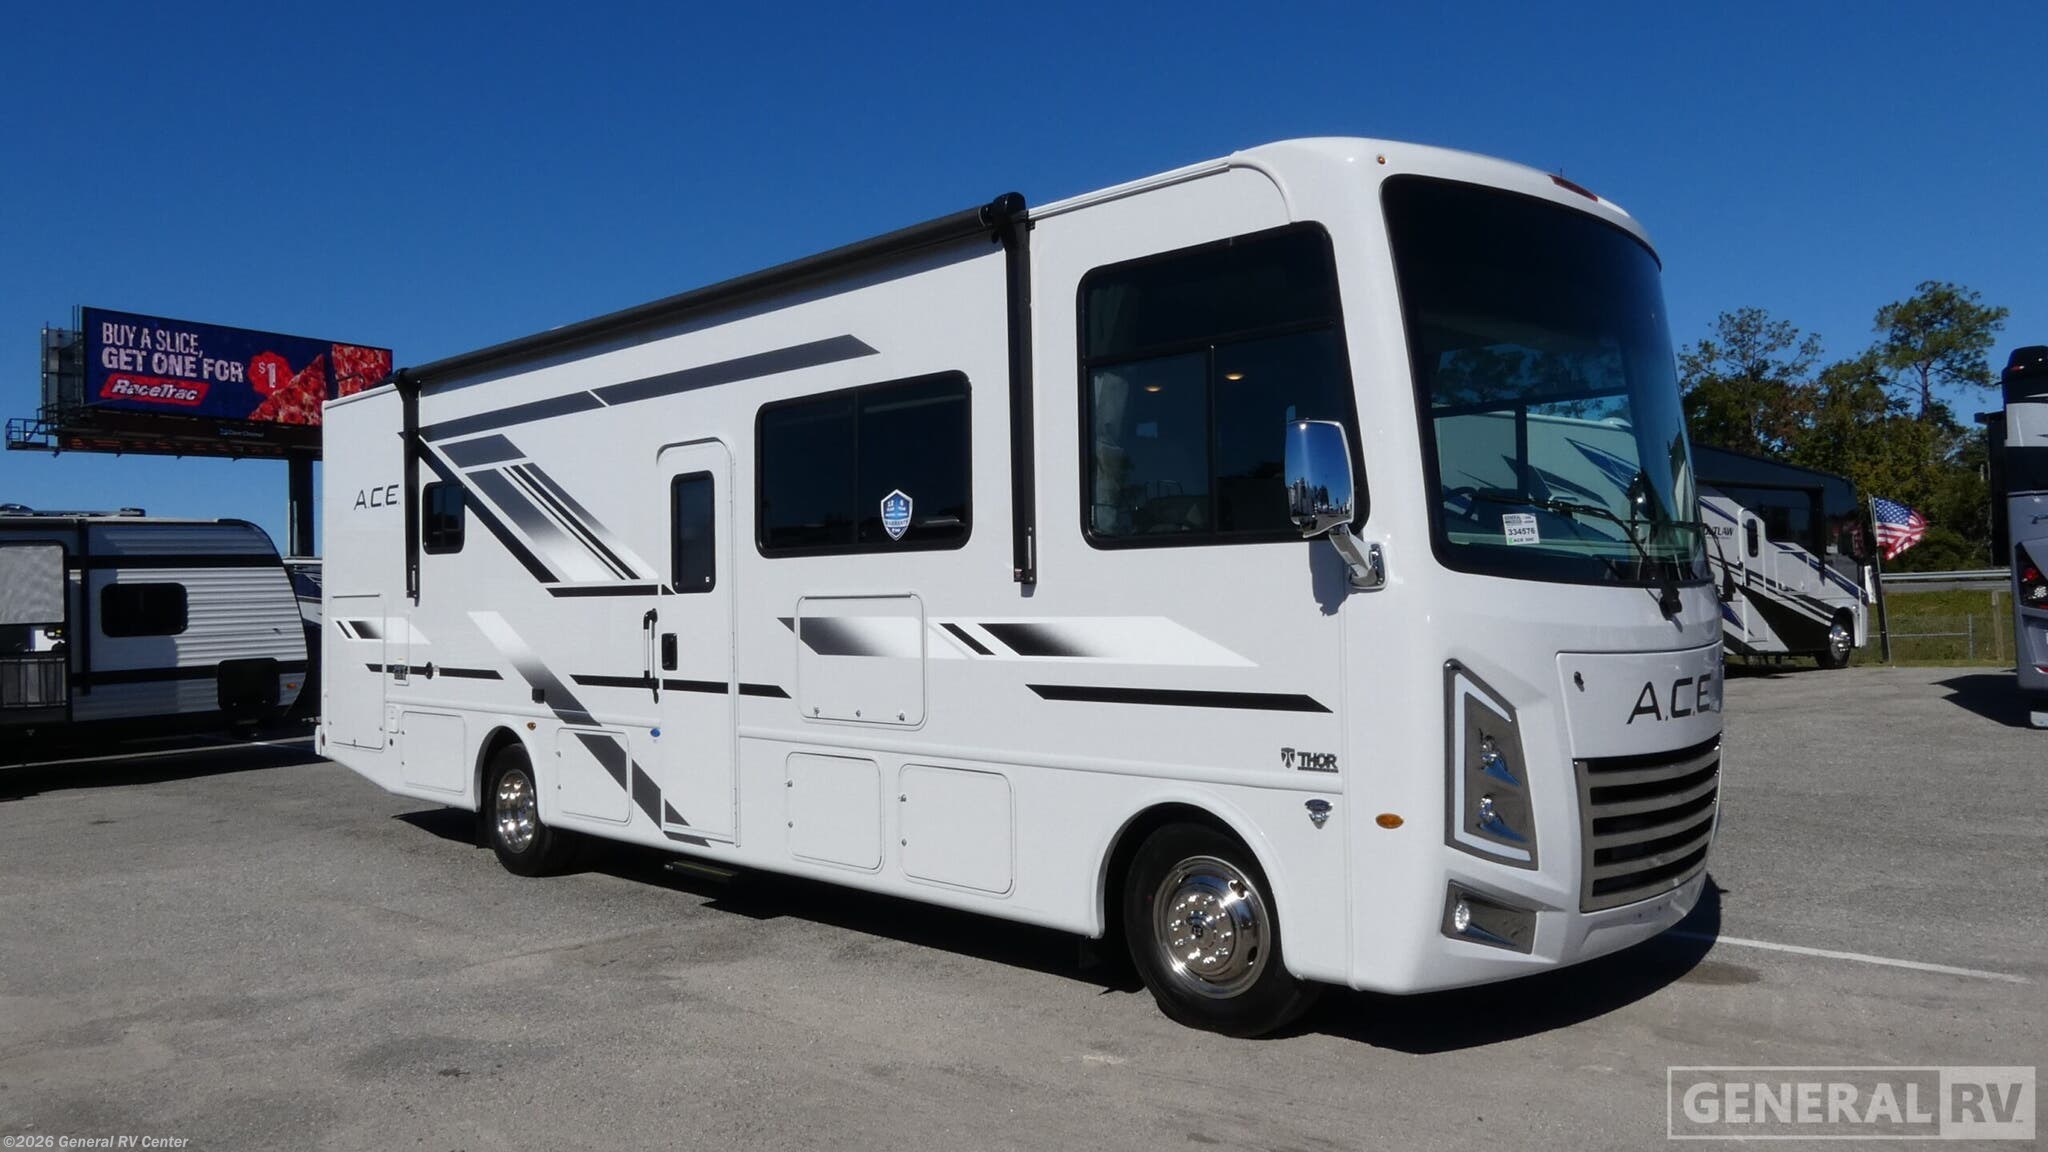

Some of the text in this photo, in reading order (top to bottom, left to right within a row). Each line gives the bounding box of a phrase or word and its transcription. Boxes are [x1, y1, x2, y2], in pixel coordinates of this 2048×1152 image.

[102, 322, 203, 358] BUY A SLICE,
[101, 346, 244, 383] GET ONE FOR
[258, 361, 277, 388] $1
[112, 379, 198, 400] RaceTrac
[1507, 527, 1536, 536] 334576
[1297, 751, 1338, 769] THOR
